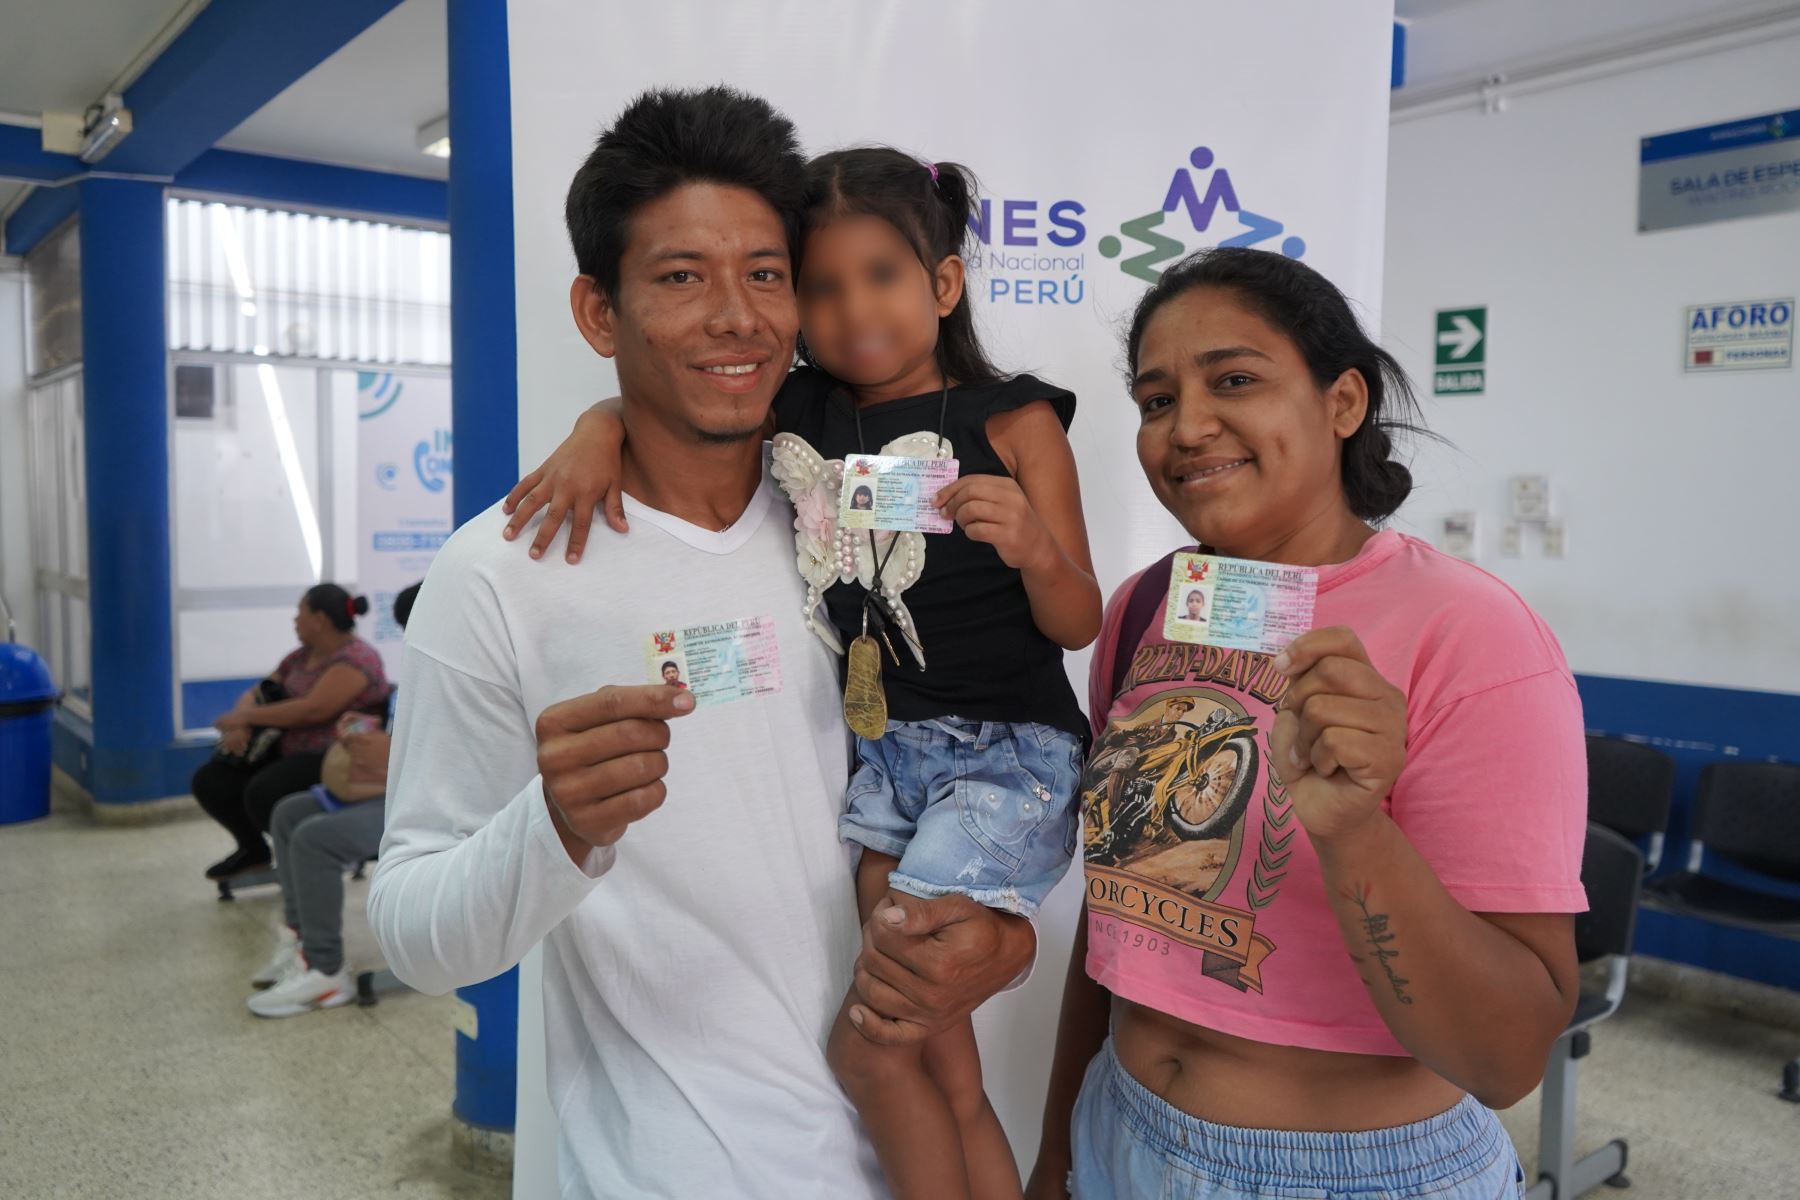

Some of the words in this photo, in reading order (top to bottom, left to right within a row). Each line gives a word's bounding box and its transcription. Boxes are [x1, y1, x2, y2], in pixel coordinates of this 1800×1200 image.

[990, 252, 1084, 271] Nacional
[991, 273, 1084, 305] PERÚ
[1692, 302, 1790, 331] AFORO
[1436, 372, 1484, 392] SALIDA
[1122, 930, 1170, 956] 1903
